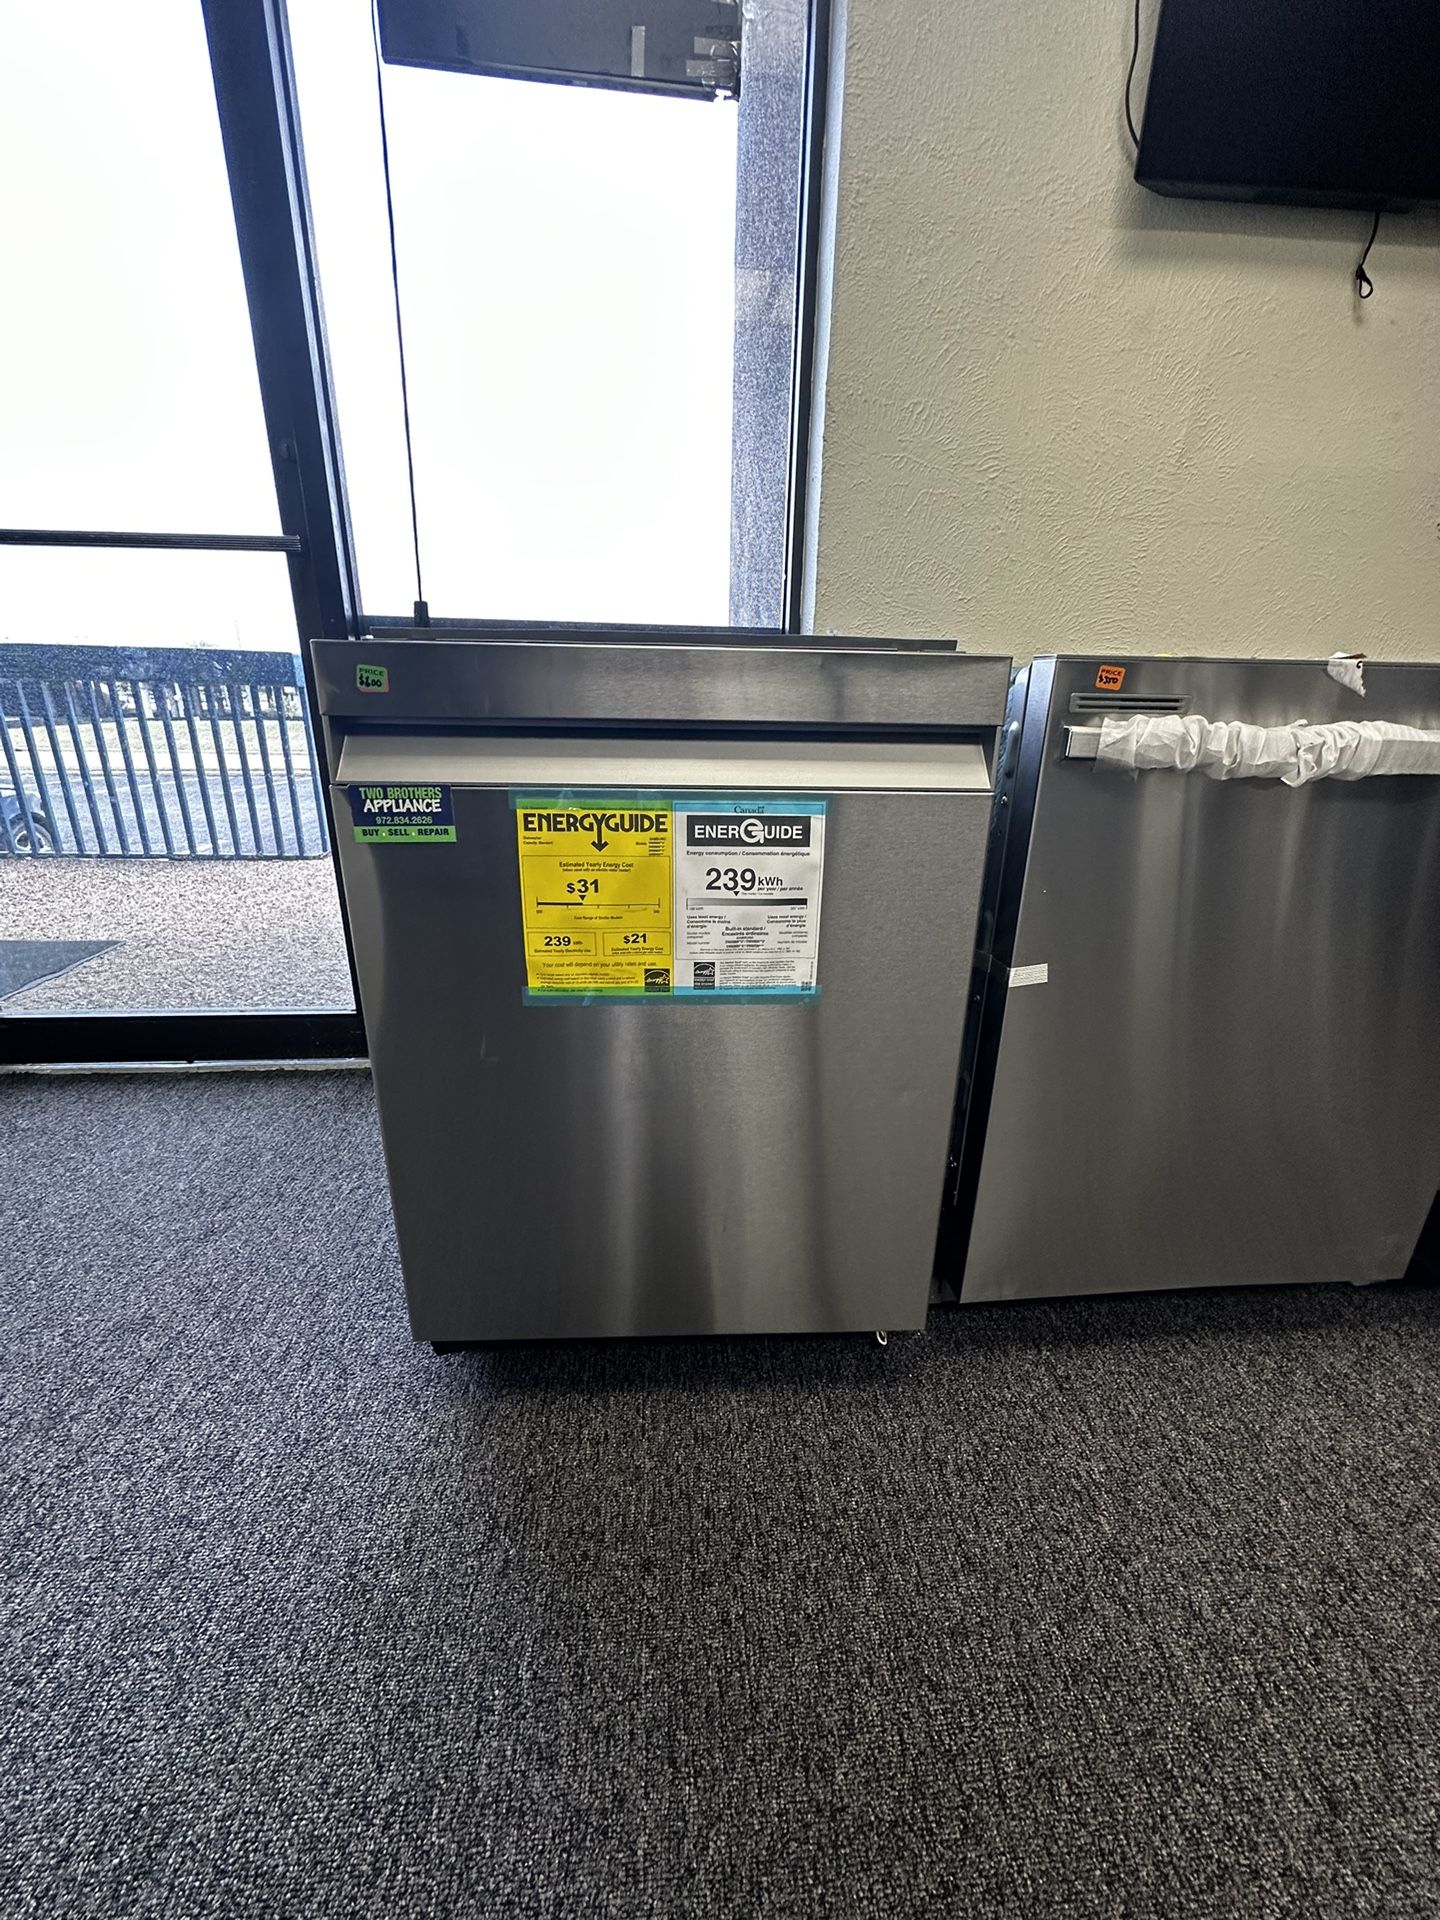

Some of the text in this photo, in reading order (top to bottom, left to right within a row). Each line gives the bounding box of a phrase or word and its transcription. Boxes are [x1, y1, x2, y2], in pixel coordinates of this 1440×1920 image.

[359, 667, 384, 677] PRICE
[359, 787, 442, 799] TWO BROTHERS
[363, 798, 442, 812] APPLIANCE
[734, 806, 764, 814] Canada
[376, 816, 432, 824] 972.834.2626
[522, 813, 668, 833] ENERGYGUIDE
[694, 818, 803, 844] ENERGUIDE
[705, 868, 782, 891] 239 kWh
[566, 878, 599, 894] $31
[544, 936, 572, 946] 239
[623, 933, 647, 944] $21
